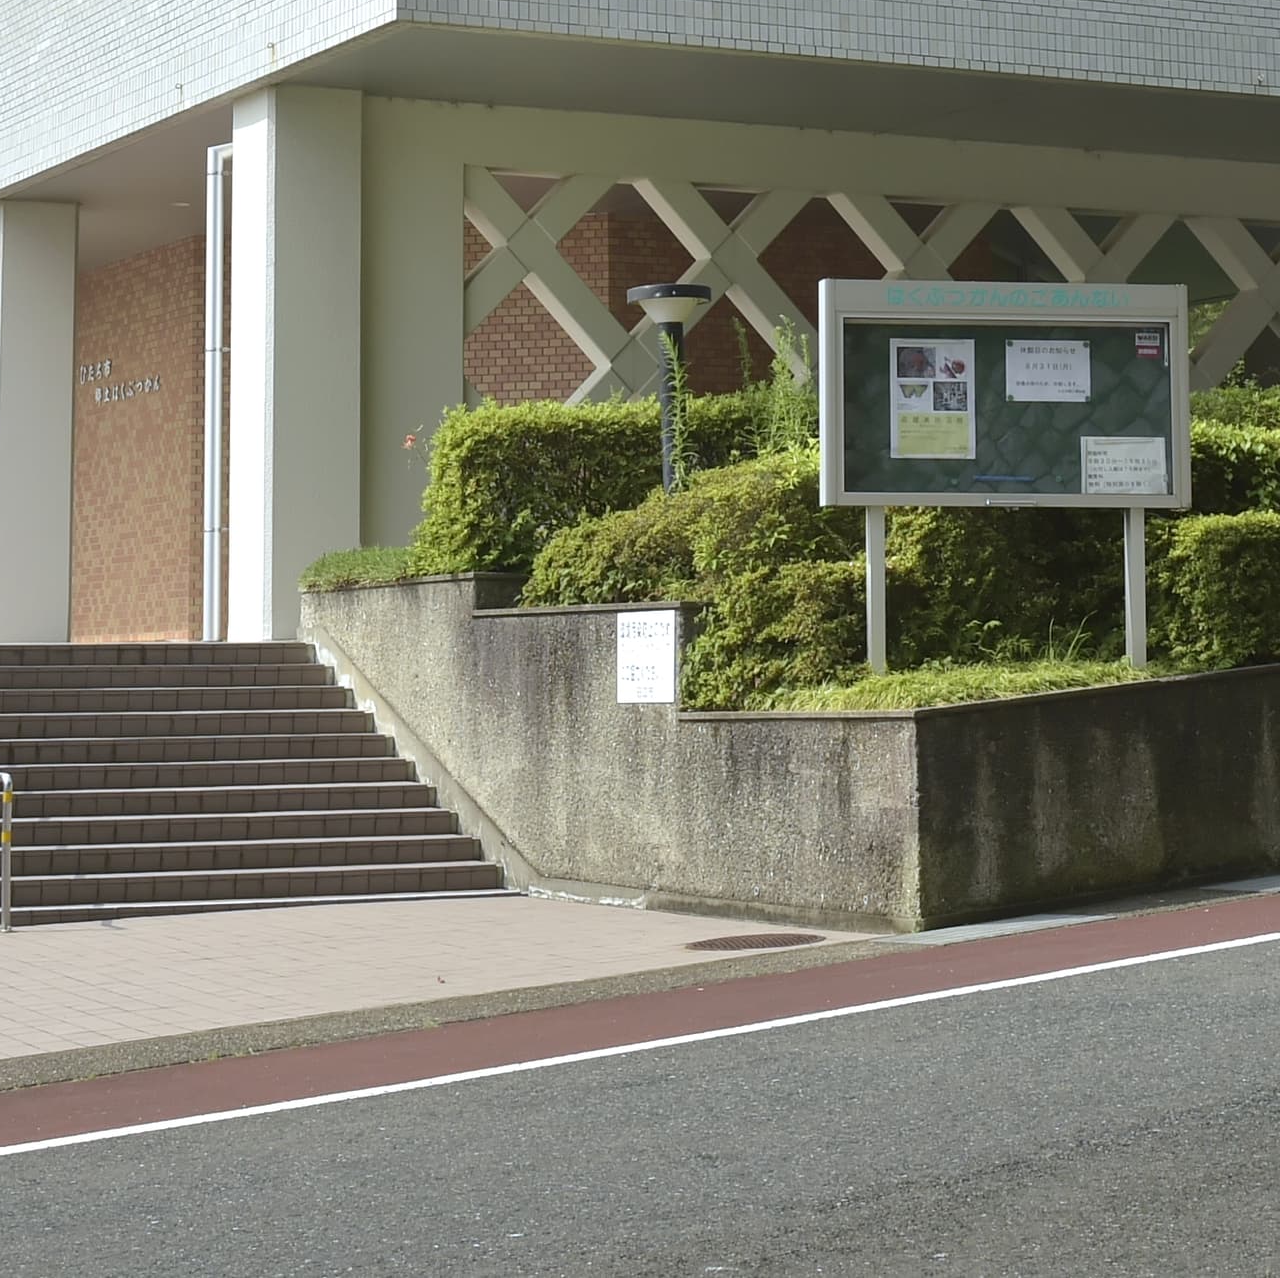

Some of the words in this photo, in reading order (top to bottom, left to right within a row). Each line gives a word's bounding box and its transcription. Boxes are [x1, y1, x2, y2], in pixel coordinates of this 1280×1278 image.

[887, 286, 1132, 308] はくぶつかんのごあんない
[80, 359, 112, 385] ひたち市
